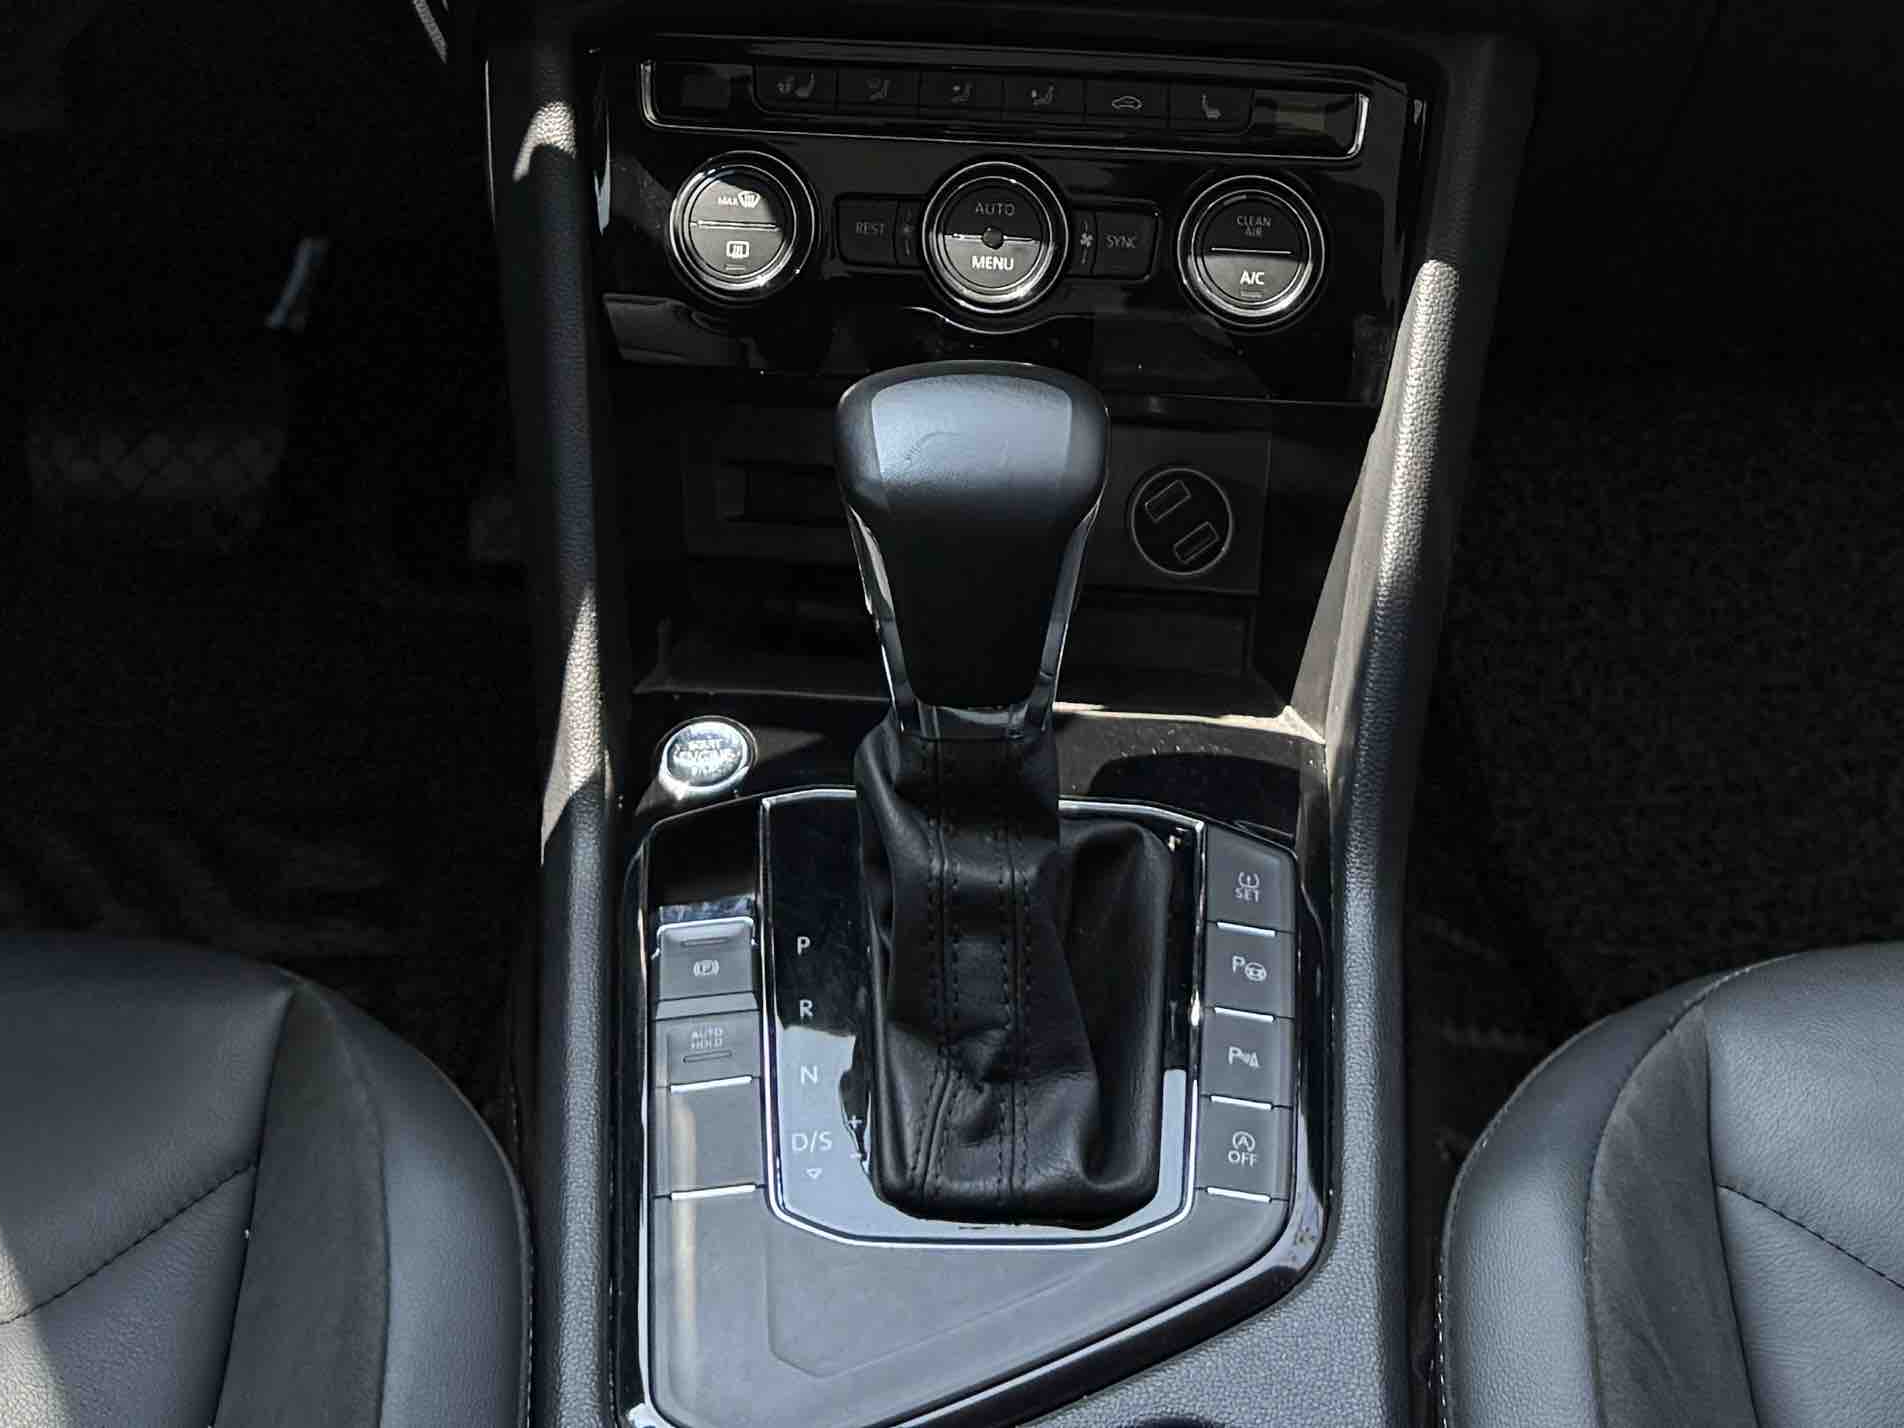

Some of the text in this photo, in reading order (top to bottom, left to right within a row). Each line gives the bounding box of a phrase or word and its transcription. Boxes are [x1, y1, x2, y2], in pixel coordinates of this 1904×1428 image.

[975, 201, 1016, 217] AUTO
[855, 222, 885, 234] REST
[1237, 215, 1272, 227] CLEAN
[1105, 236, 1137, 249] SYNC
[971, 255, 1015, 271] MENU
[1240, 271, 1265, 285] A/C
[1235, 887, 1260, 902] SET
[797, 936, 811, 956] P
[799, 999, 815, 1018] R
[800, 1065, 818, 1085] N
[791, 1131, 833, 1153] D/S
[1228, 1151, 1257, 1167] OFF
